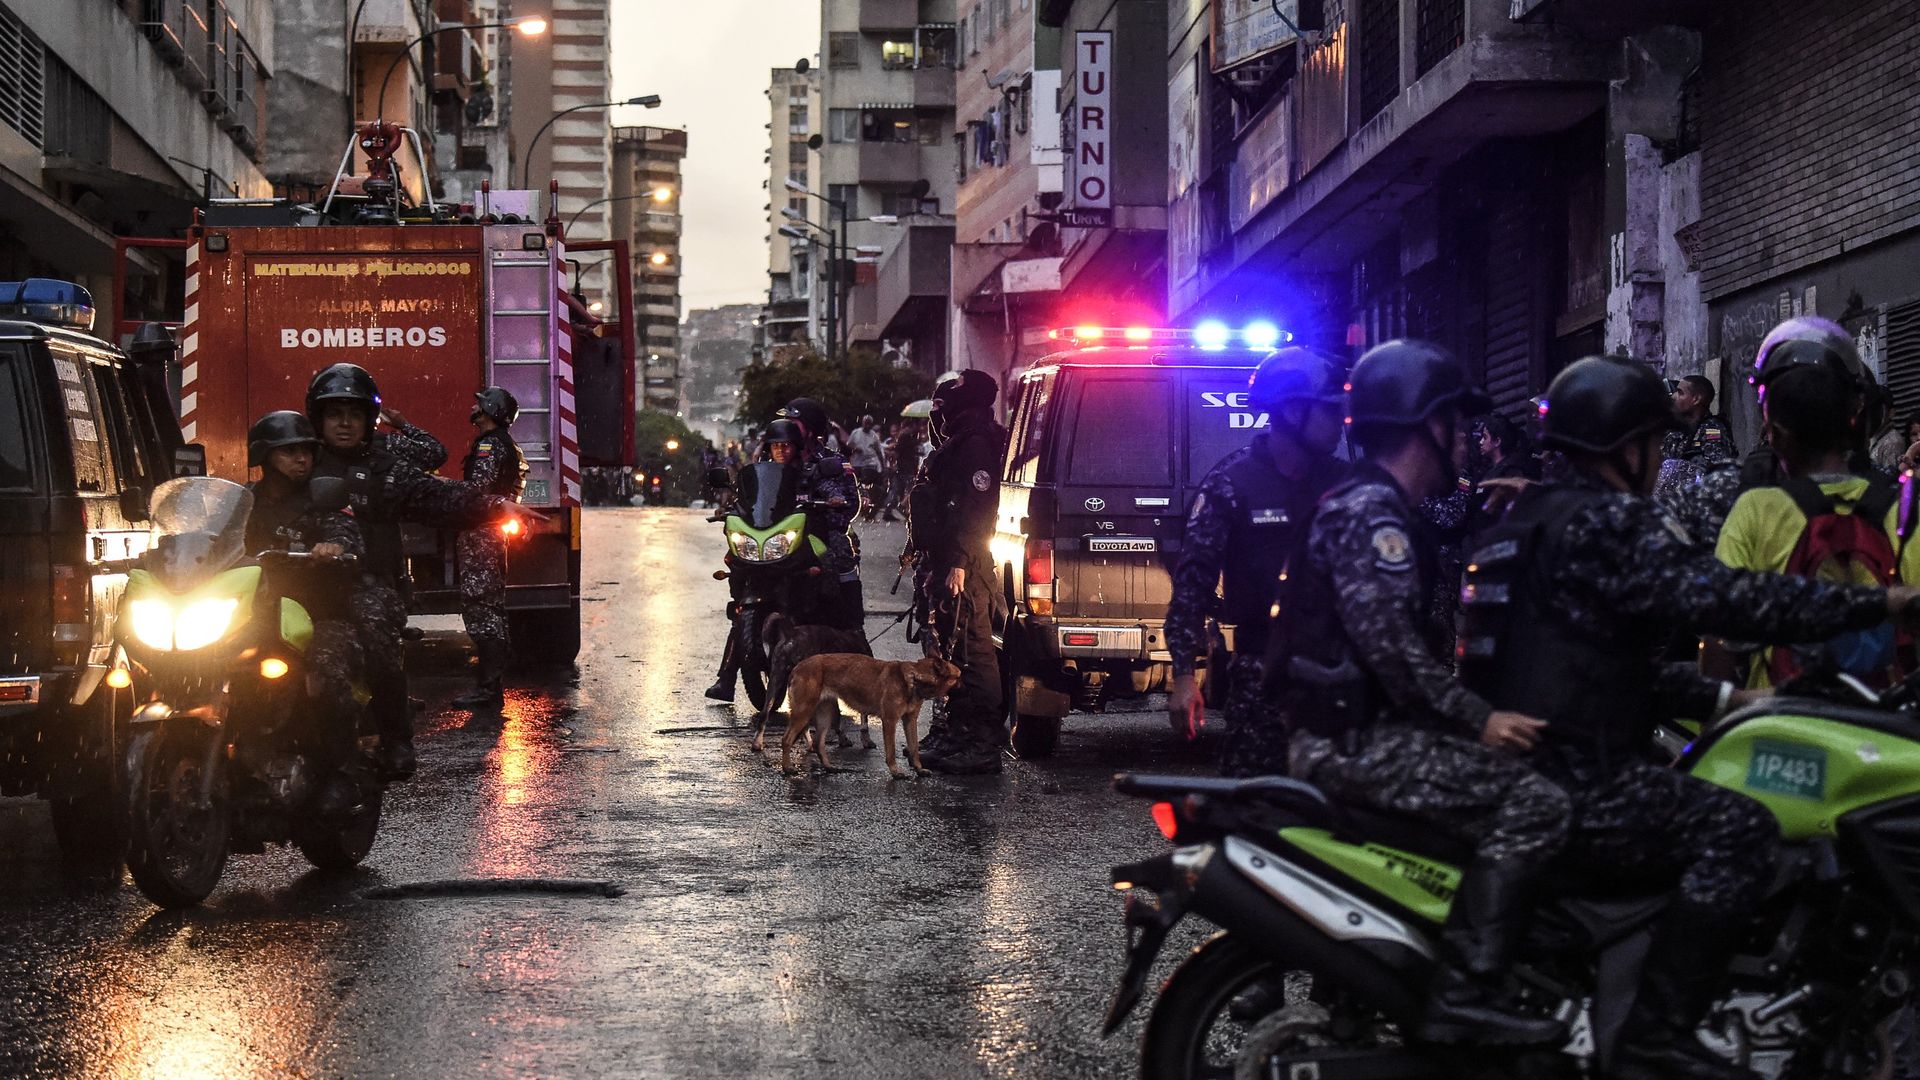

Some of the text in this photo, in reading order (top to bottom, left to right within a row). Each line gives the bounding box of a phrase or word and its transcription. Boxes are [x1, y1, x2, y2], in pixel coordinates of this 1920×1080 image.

[1080, 40, 1105, 201] TURNO
[254, 262, 471, 277] MATERIALES PELIGROSOS
[281, 326, 447, 348] BOMBEROS
[1096, 521, 1115, 530] V6
[1756, 752, 1819, 787] 1P483
